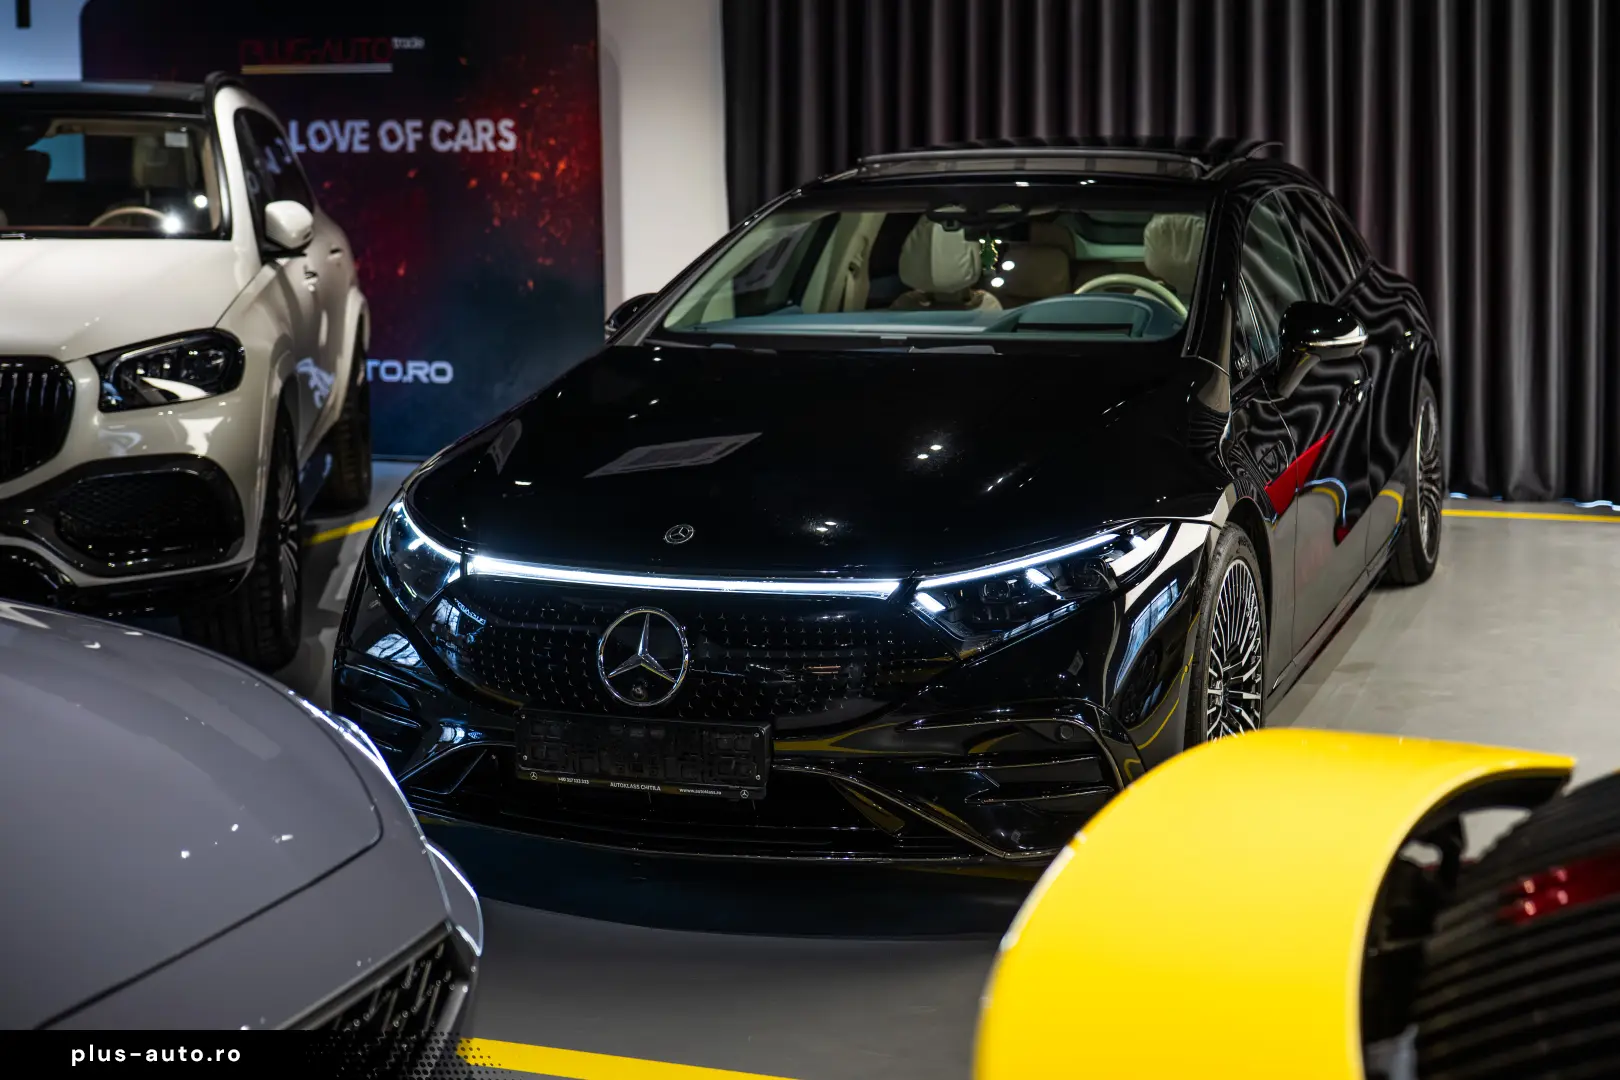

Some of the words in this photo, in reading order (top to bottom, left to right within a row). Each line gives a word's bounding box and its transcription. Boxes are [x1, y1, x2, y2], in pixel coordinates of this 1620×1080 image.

[288, 119, 370, 153] LOVE
[377, 119, 423, 152] OF
[430, 118, 517, 152] CARS
[610, 781, 640, 790] AUTOKLASS
